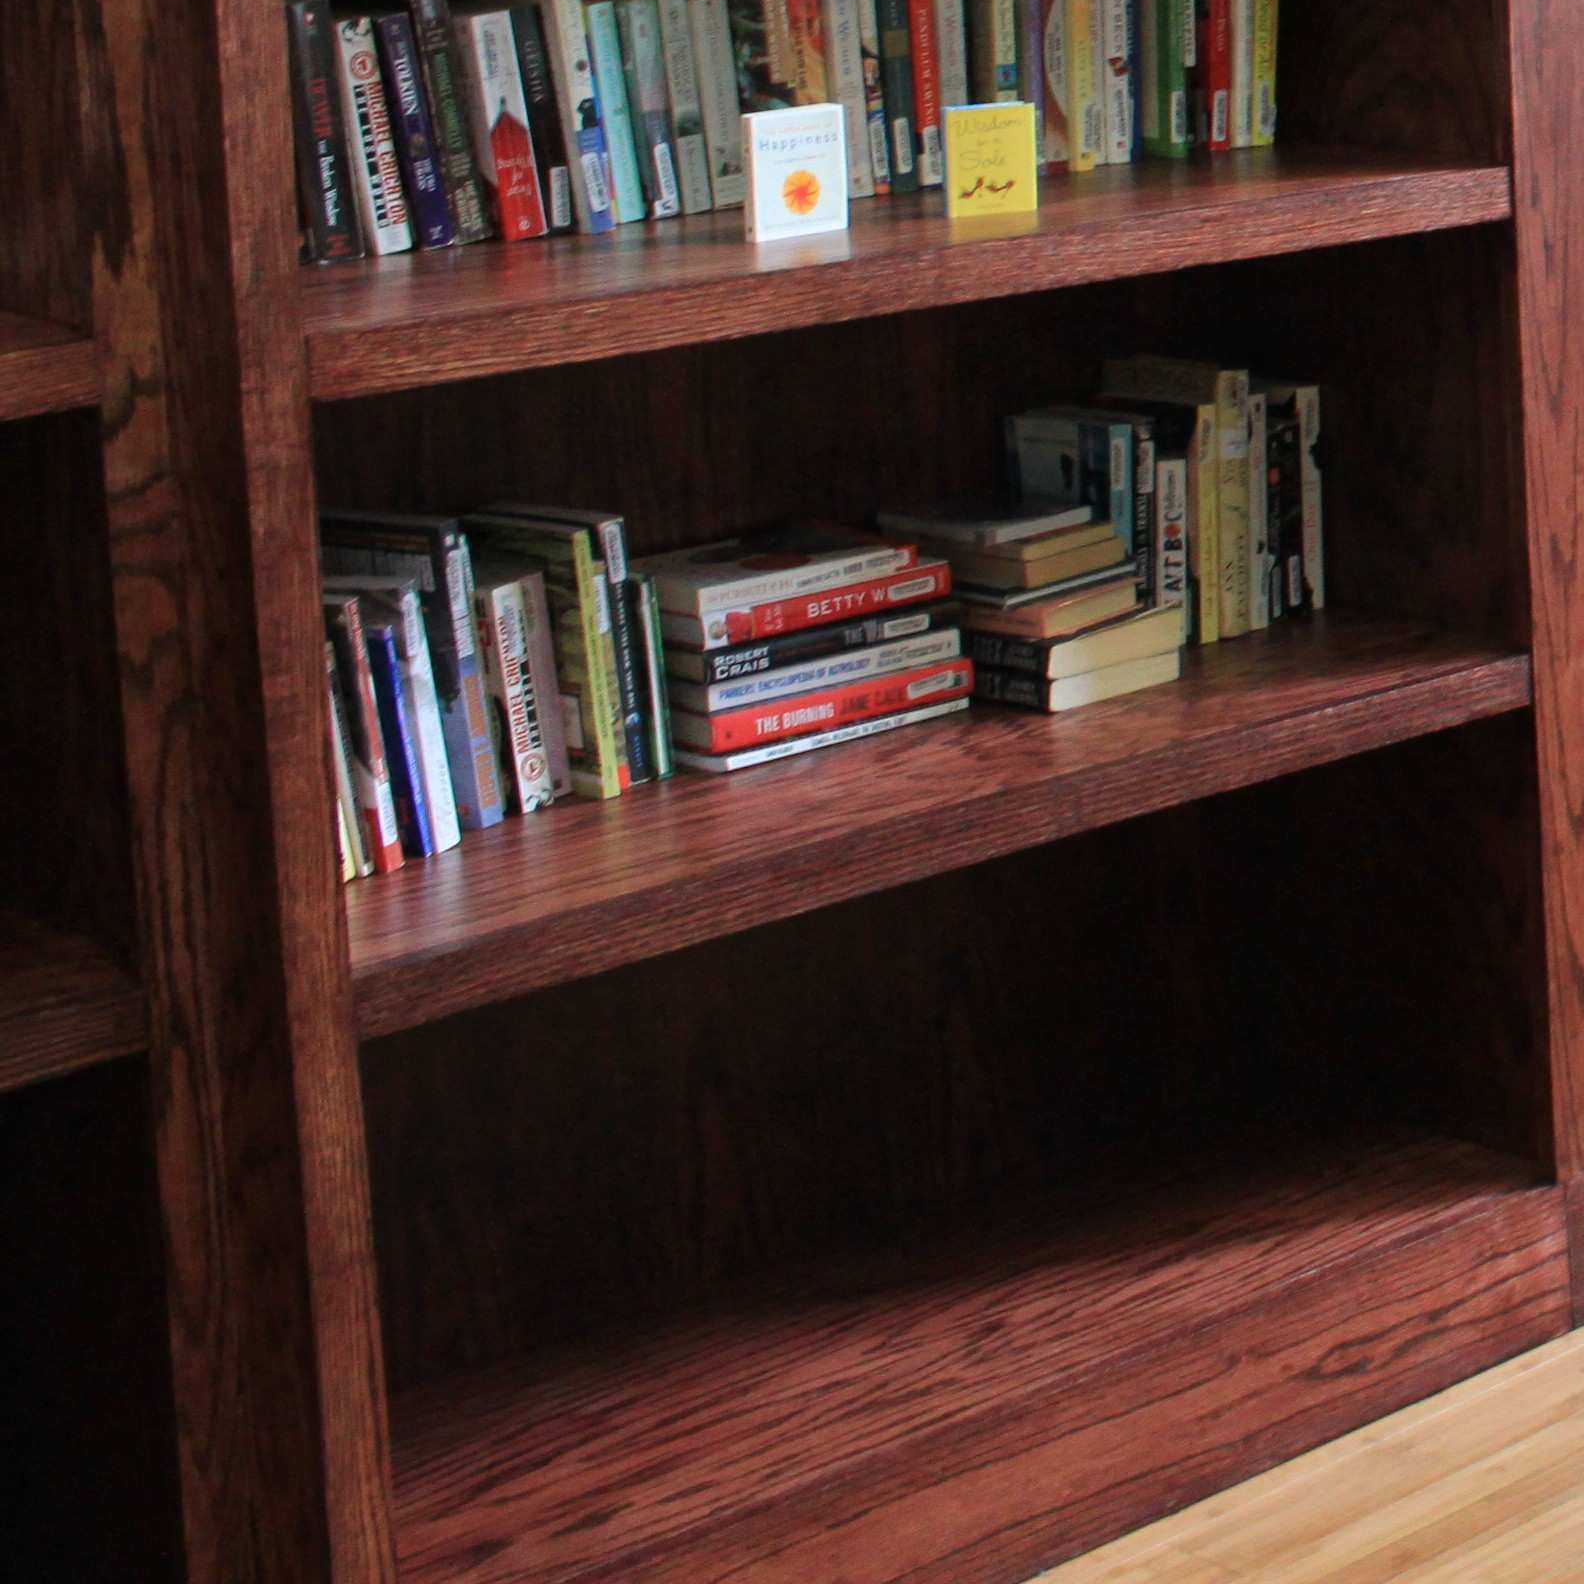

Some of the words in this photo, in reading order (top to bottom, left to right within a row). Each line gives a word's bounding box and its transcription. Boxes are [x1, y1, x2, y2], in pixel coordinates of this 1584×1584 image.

[918, 7, 931, 79] PENDULUM
[1112, 15, 1123, 52] BECK
[396, 55, 417, 115] TOLKIEN
[923, 82, 934, 124] SWING
[354, 83, 367, 112] THE
[362, 123, 377, 162] LOST
[372, 173, 390, 228] WORLD
[367, 79, 390, 145] MICHAEL
[381, 149, 405, 224] CRICHTON
[806, 592, 866, 618] BETTY
[713, 646, 769, 668] ROBERT
[715, 657, 770, 680] CRAIS
[757, 671, 815, 692] ENCYCLOPEDIA
[828, 657, 871, 677] ASTROLOGY
[509, 690, 531, 753] MICHAEL
[756, 716, 781, 735] THE
[783, 703, 835, 729] BURNING
